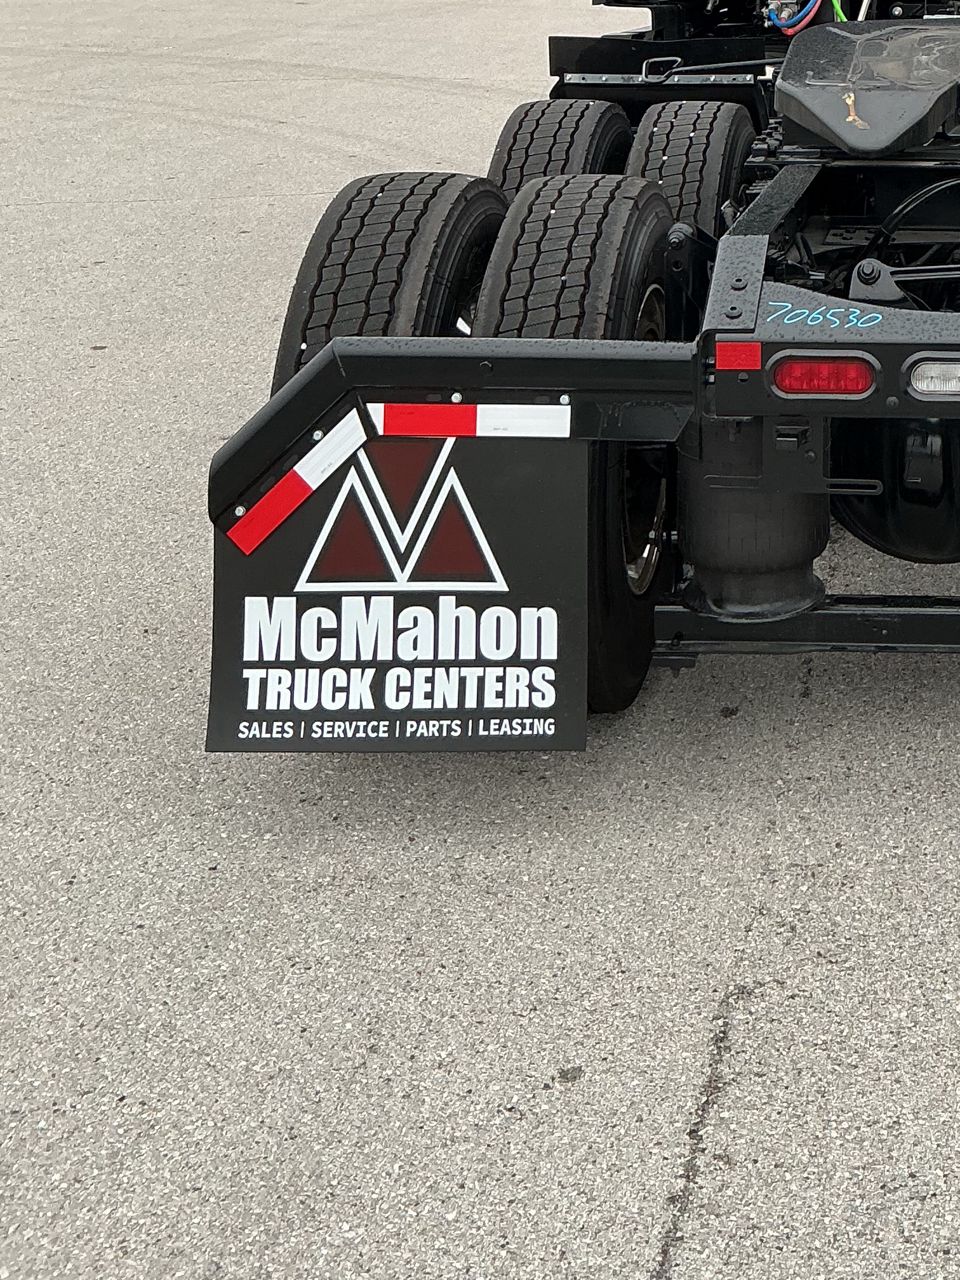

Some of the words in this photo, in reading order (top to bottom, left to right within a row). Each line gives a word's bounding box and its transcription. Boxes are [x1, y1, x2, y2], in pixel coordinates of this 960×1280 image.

[766, 301, 883, 328] 706530
[242, 595, 558, 662] McMahon
[242, 667, 377, 711] TRUCK
[384, 665, 556, 711] CENTERS
[237, 721, 294, 739] SALES
[310, 720, 390, 739] SERVICE
[405, 719, 462, 738] PARTS
[478, 718, 556, 736] LEASING
